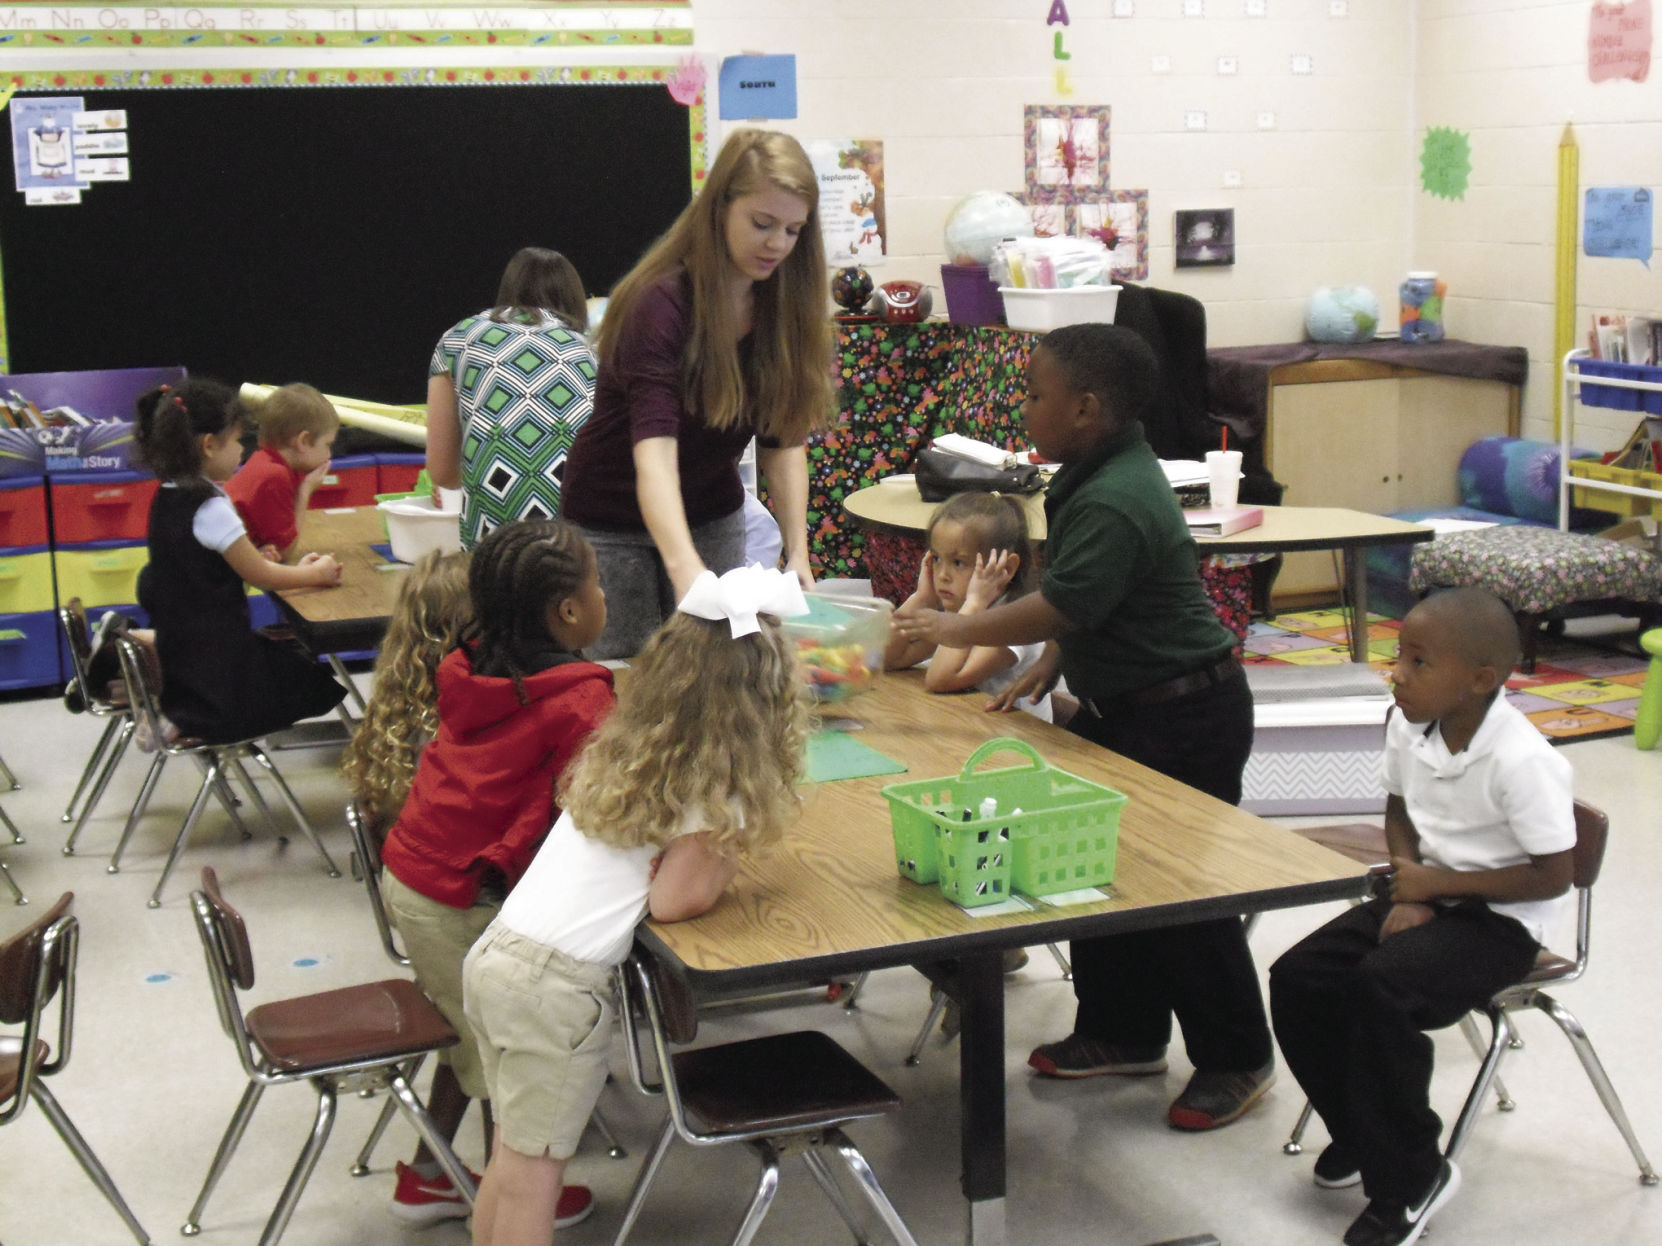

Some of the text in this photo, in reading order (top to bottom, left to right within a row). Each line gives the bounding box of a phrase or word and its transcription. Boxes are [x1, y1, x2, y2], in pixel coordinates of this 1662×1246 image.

[51, 9, 84, 28] Nn
[143, 9, 171, 30] Pp
[184, 8, 216, 30] Qq
[239, 9, 264, 28] Rr
[286, 9, 307, 28] Ss
[327, 9, 349, 28] Tt
[374, 10, 399, 29] Uu
[424, 10, 445, 28] Vv
[472, 10, 513, 28] Ww
[543, 10, 567, 28] Xx
[601, 10, 620, 28] Yy
[652, 9, 676, 27] Zz
[821, 173, 861, 183] September
[88, 455, 121, 469] Story
